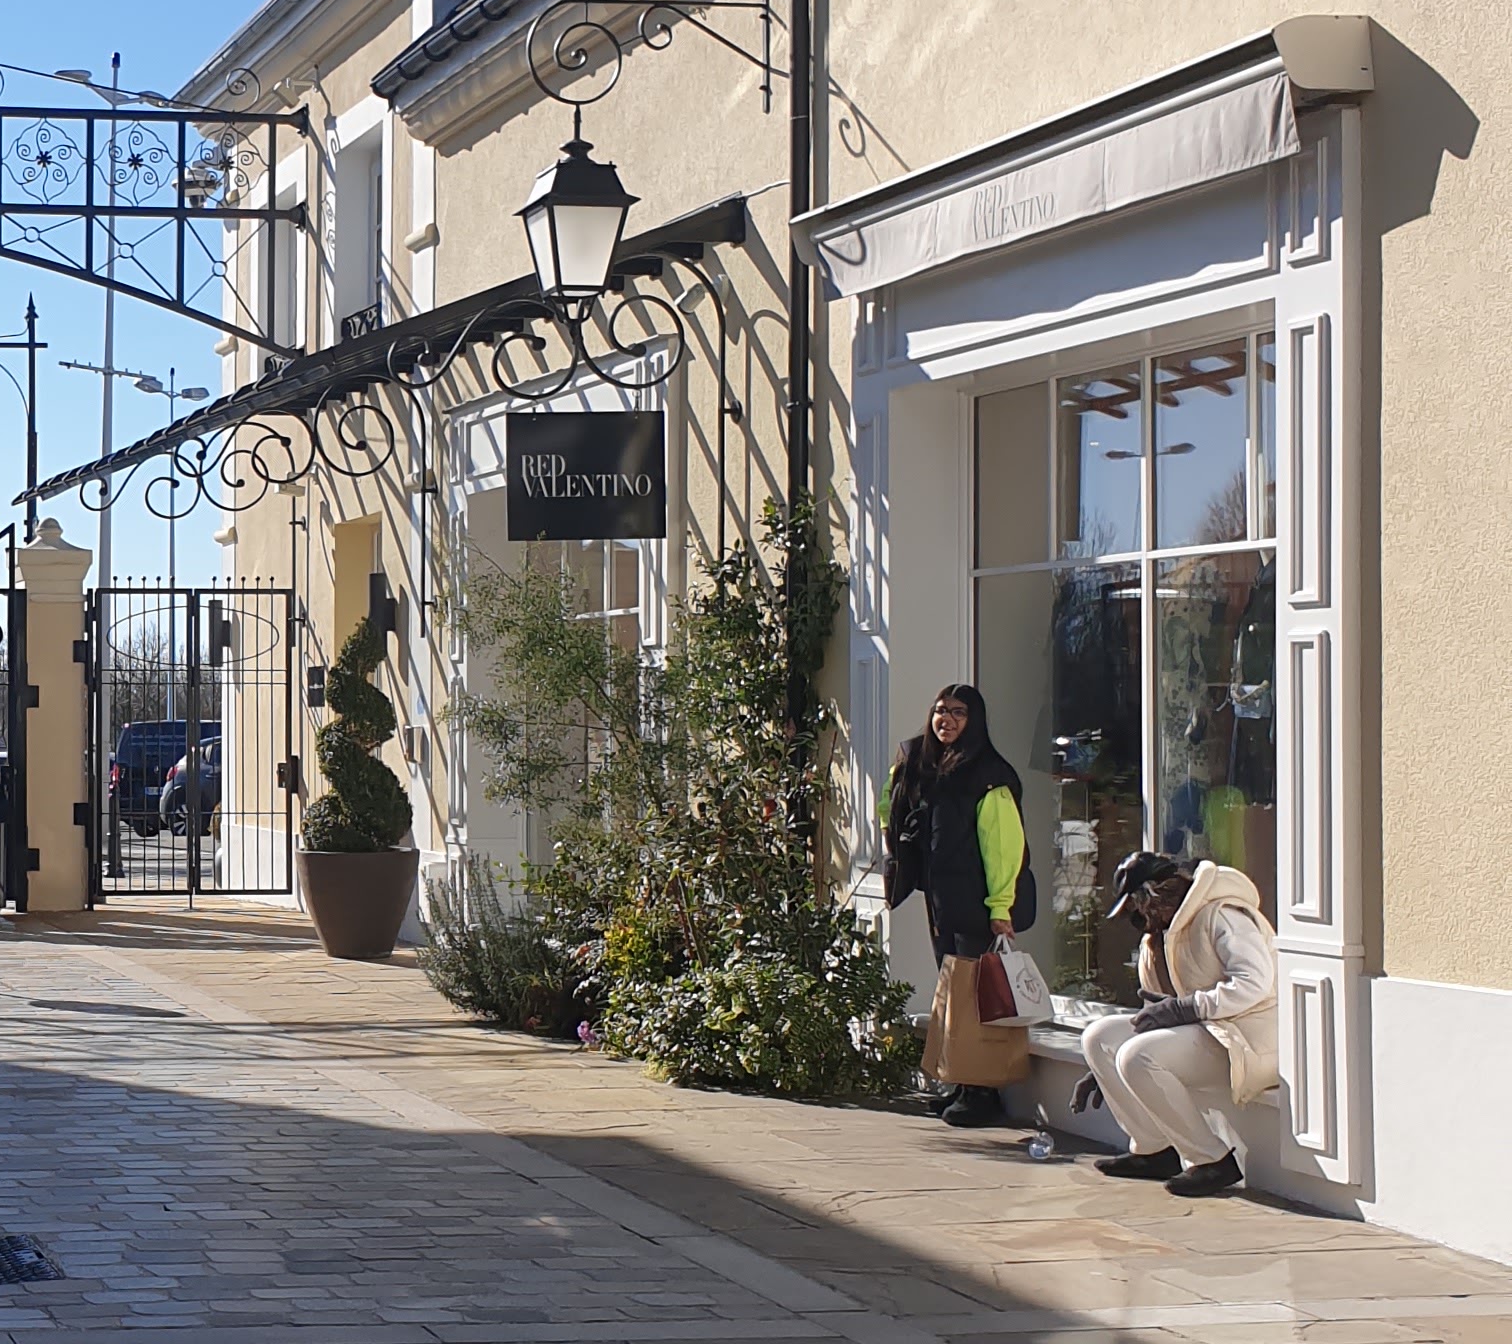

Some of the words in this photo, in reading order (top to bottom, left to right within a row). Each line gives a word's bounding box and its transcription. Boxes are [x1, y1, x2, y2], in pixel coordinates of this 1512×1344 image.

[974, 185, 1003, 216] RED
[521, 454, 566, 476] RED
[522, 474, 652, 497] VALENTINO
